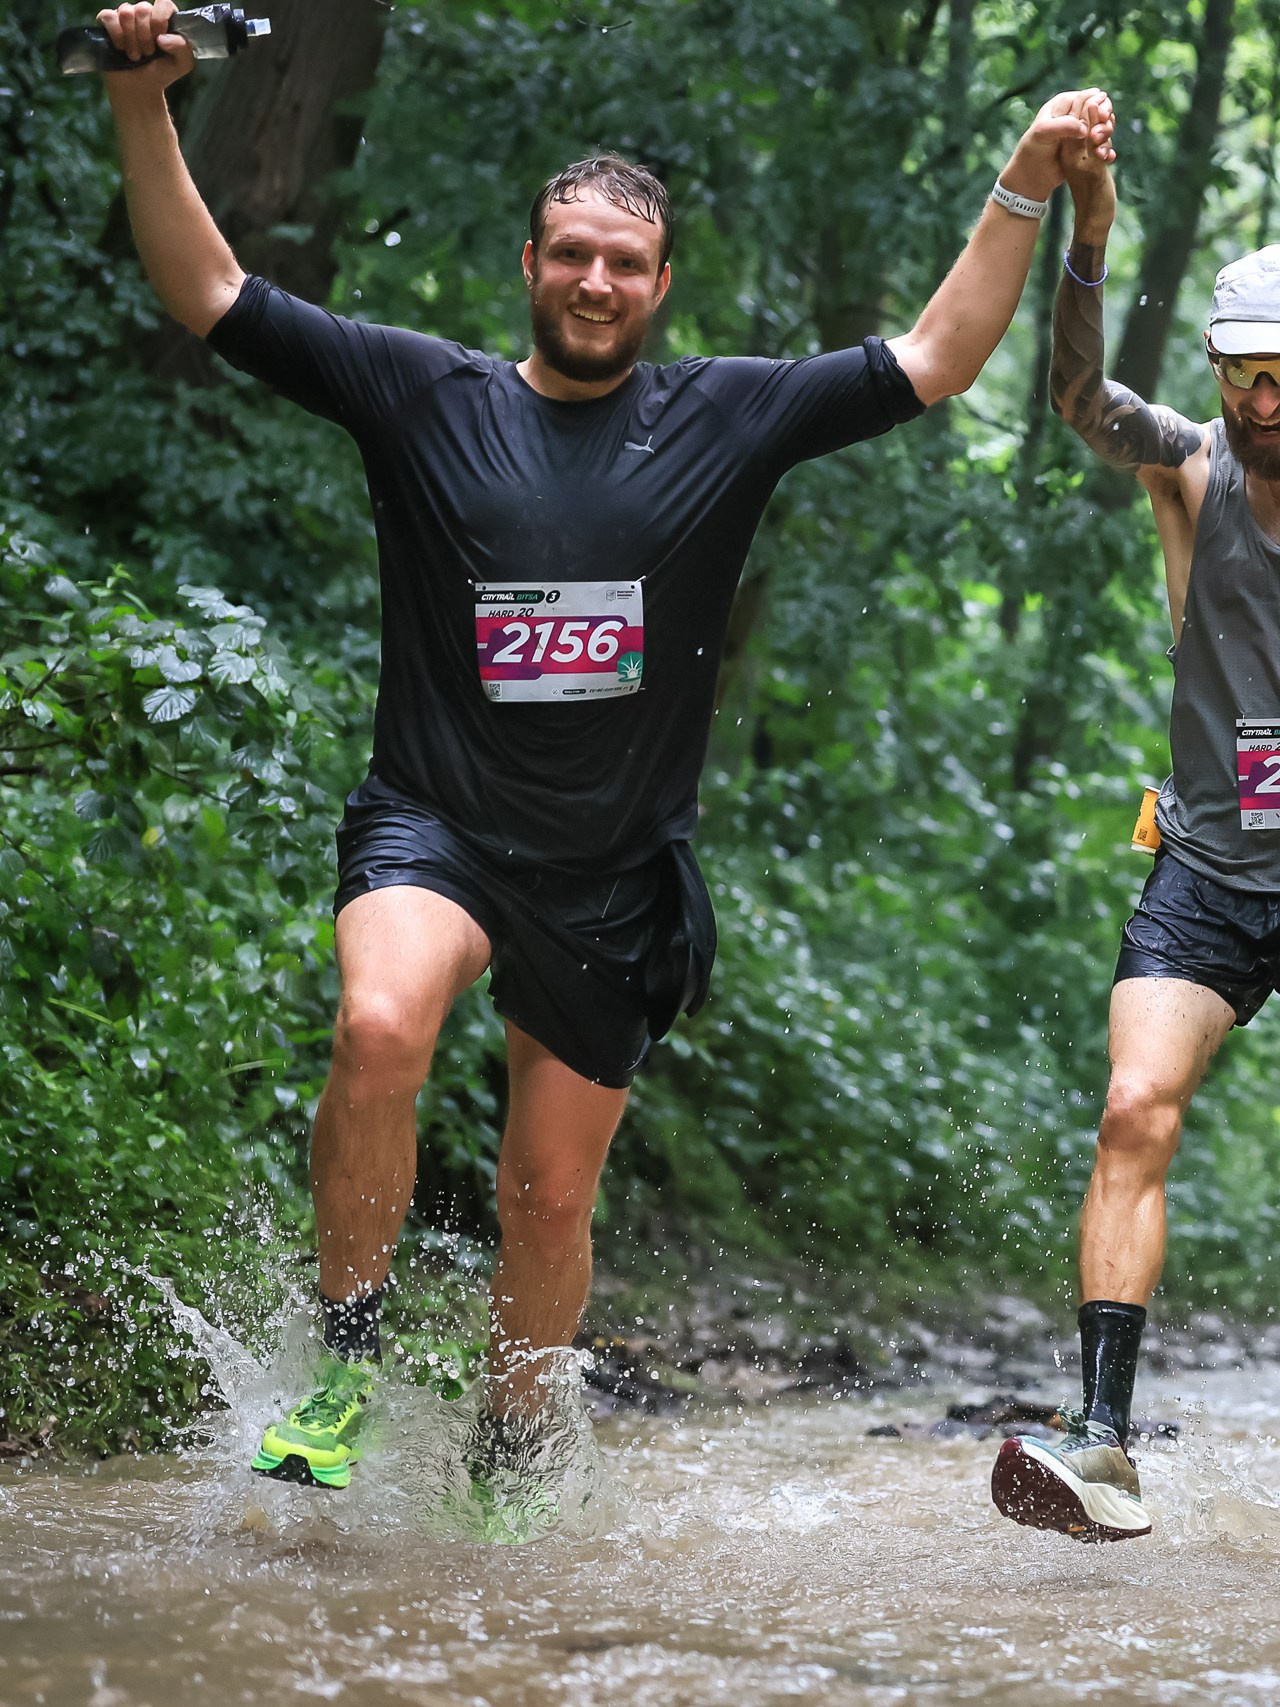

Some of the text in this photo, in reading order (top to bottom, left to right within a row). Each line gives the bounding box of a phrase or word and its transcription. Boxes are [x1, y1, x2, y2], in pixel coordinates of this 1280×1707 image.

[516, 593, 538, 601] BITSA
[488, 607, 534, 618] HARD 20
[492, 620, 624, 663] 2156
[1249, 744, 1273, 752] HARD
